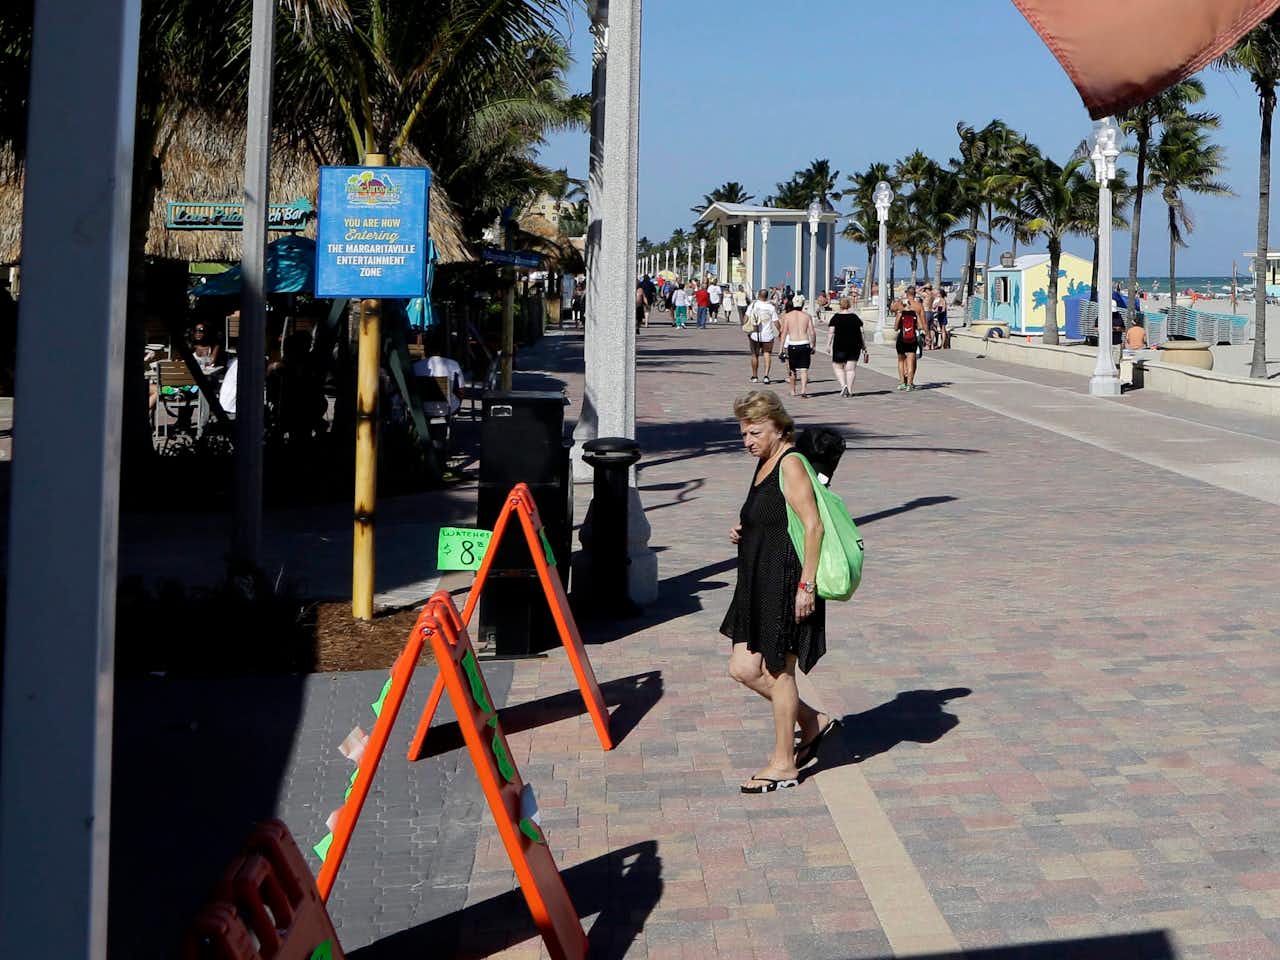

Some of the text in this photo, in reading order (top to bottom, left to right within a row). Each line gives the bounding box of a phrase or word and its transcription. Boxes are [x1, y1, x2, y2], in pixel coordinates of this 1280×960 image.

[282, 207, 304, 221] Bar
[345, 218, 400, 227] YOU ARE NOW
[345, 228, 399, 243] Entering
[328, 244, 415, 253] THE MARGARITAVILLE
[337, 256, 405, 265] ENTERTAINMENT
[360, 268, 382, 277] ZONE
[442, 530, 490, 538] WATCHES
